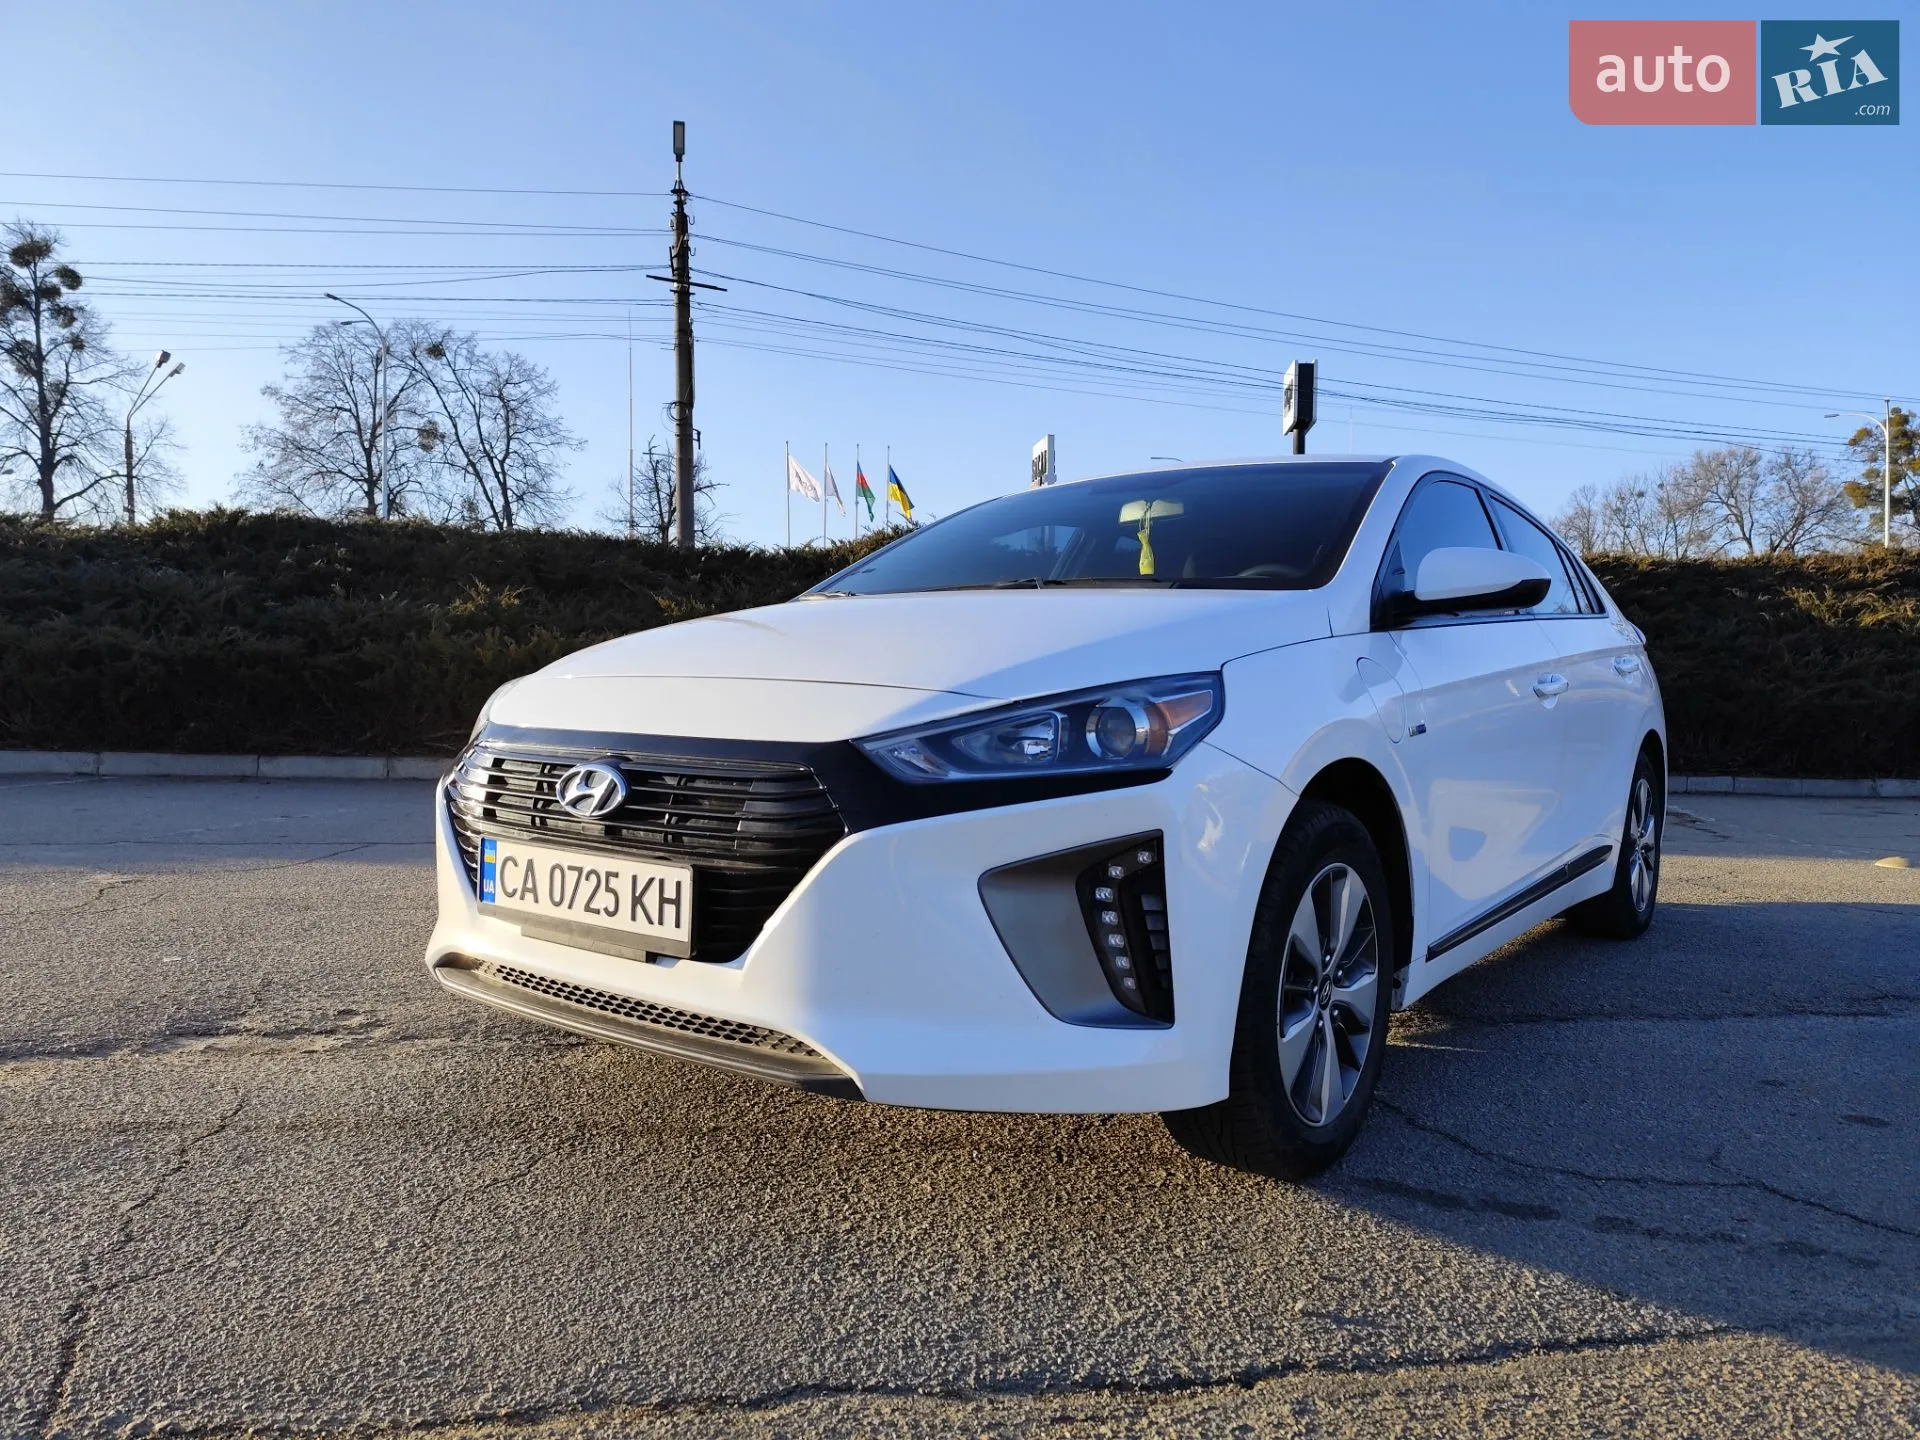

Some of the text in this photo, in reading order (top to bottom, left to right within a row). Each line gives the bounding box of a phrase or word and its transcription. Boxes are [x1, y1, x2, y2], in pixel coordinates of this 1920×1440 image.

[483, 878, 495, 894] UA
[499, 855, 683, 929] CA 0725 KH
